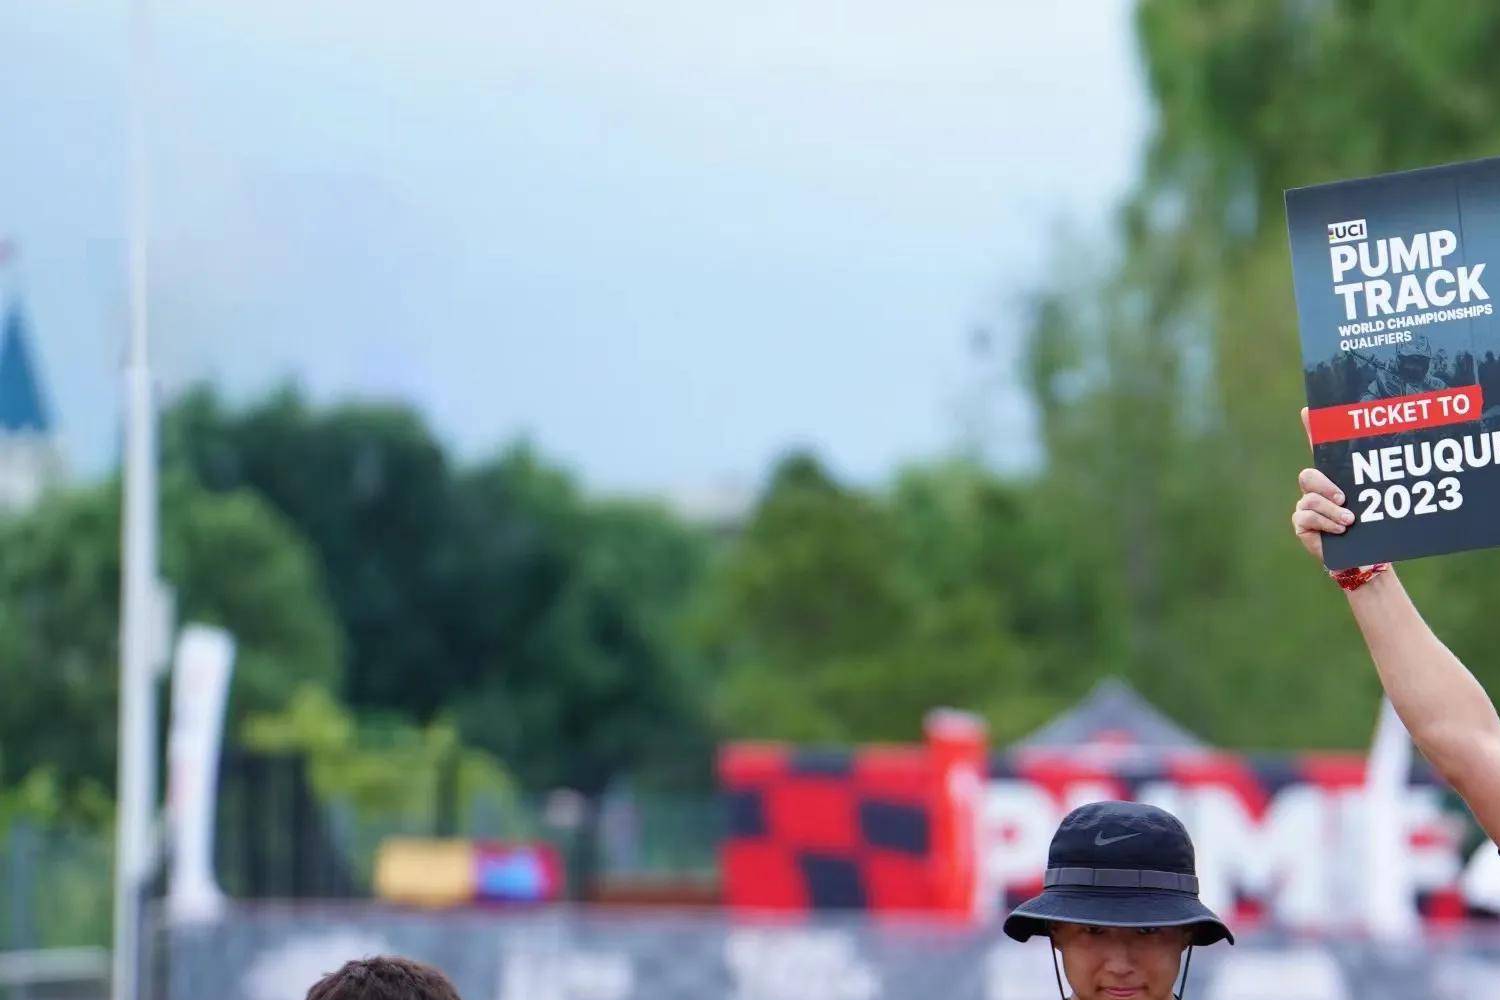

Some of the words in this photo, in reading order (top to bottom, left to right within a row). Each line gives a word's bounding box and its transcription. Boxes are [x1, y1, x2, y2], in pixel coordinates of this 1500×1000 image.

[1334, 223, 1364, 239] UCI
[1329, 229, 1457, 283] PUMP
[1334, 263, 1490, 320] TRACK
[1338, 320, 1384, 337] WORLD
[1387, 303, 1493, 330] CHAMPIONSHIPS
[1340, 330, 1412, 351] QUALIFIERS
[1348, 399, 1431, 429] TICKET
[1437, 394, 1470, 416] TO
[1357, 477, 1464, 523] 2023
